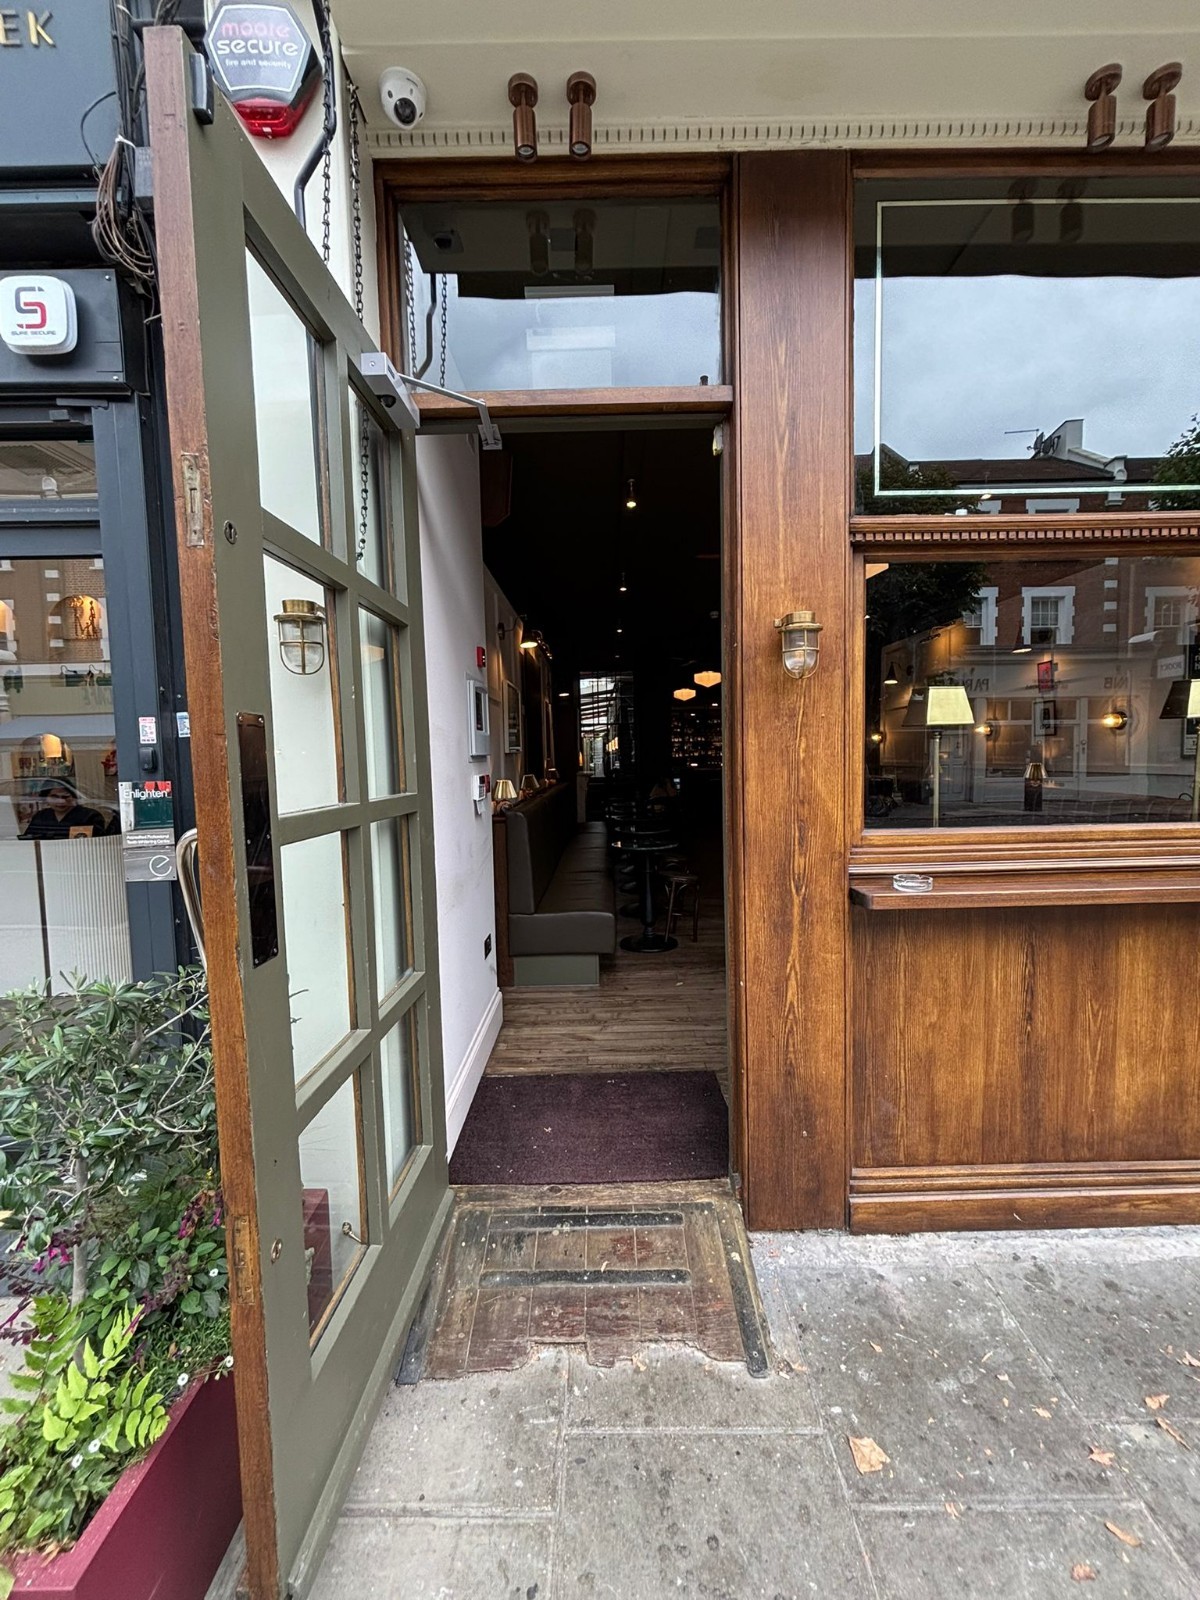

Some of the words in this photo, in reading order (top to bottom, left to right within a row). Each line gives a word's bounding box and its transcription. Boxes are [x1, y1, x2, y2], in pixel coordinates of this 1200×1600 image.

[221, 22, 290, 37] moore
[216, 39, 298, 56] secure
[240, 58, 257, 67] and
[124, 789, 168, 800] Enlighten
